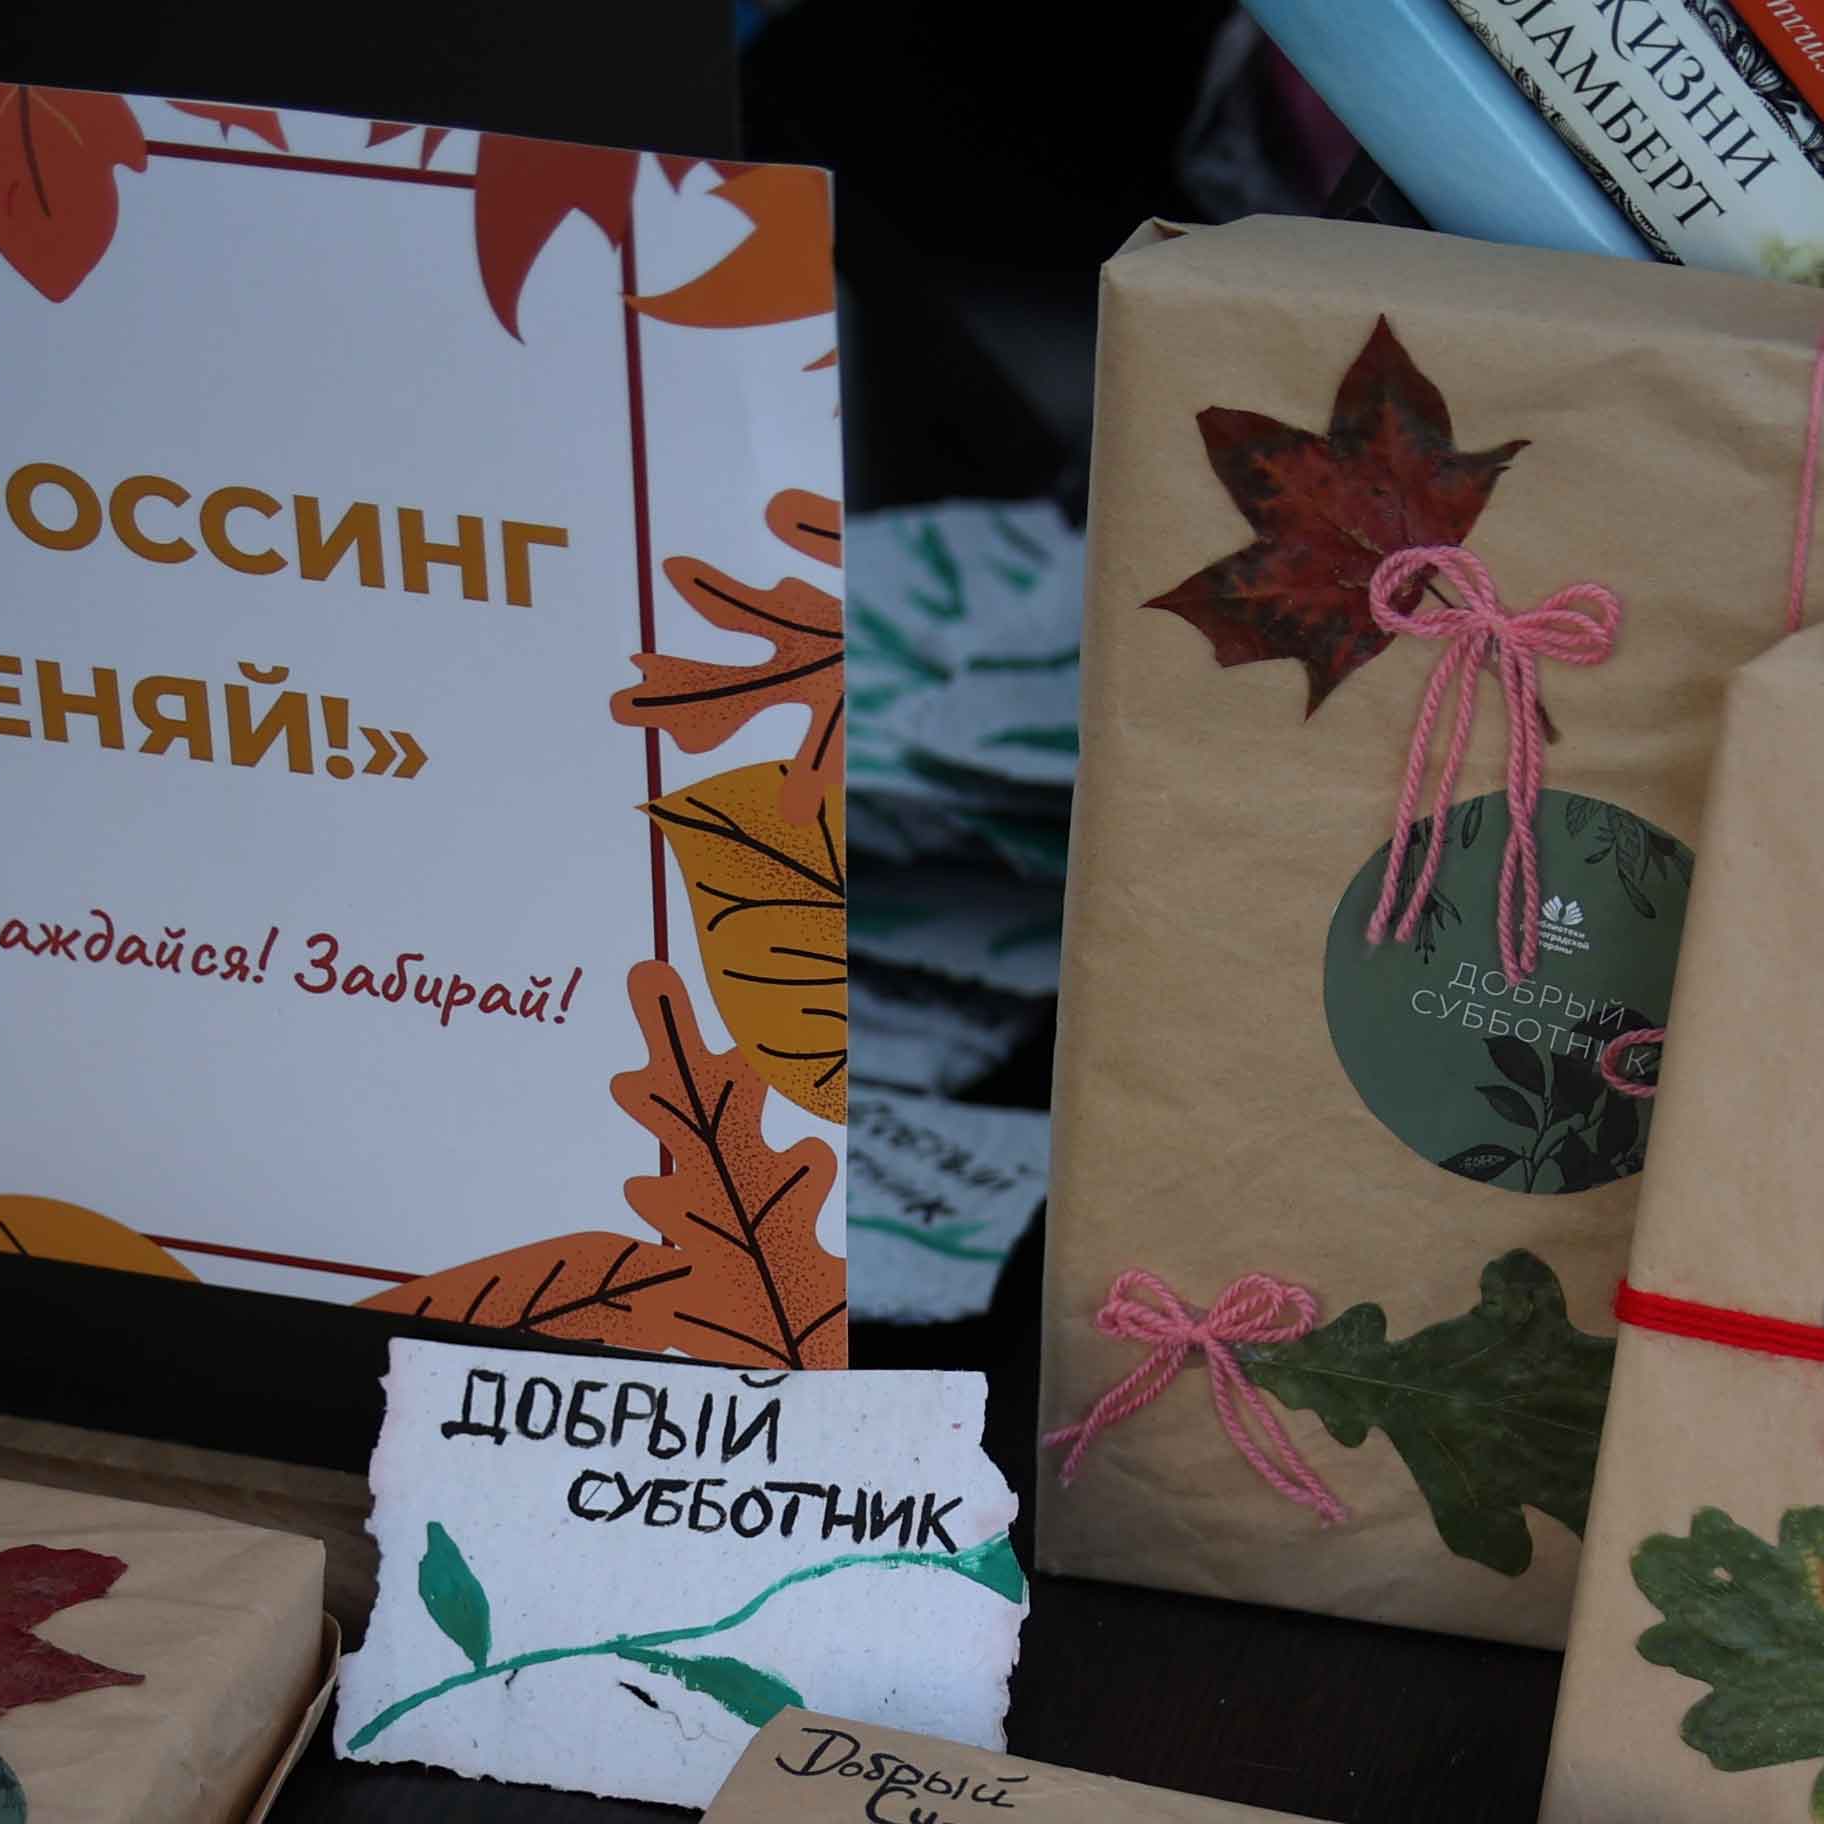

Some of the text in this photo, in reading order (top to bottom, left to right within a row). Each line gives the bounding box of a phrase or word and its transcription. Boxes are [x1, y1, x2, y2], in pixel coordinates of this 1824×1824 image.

[294, 931, 583, 1026] Забирай!
[1448, 961, 1625, 1030] ДОБРЫЙ
[440, 1368, 790, 1464] ДОБРЫЙ
[567, 1469, 963, 1553] СУББОТНИК
[774, 1726, 1029, 1809] Добрый
